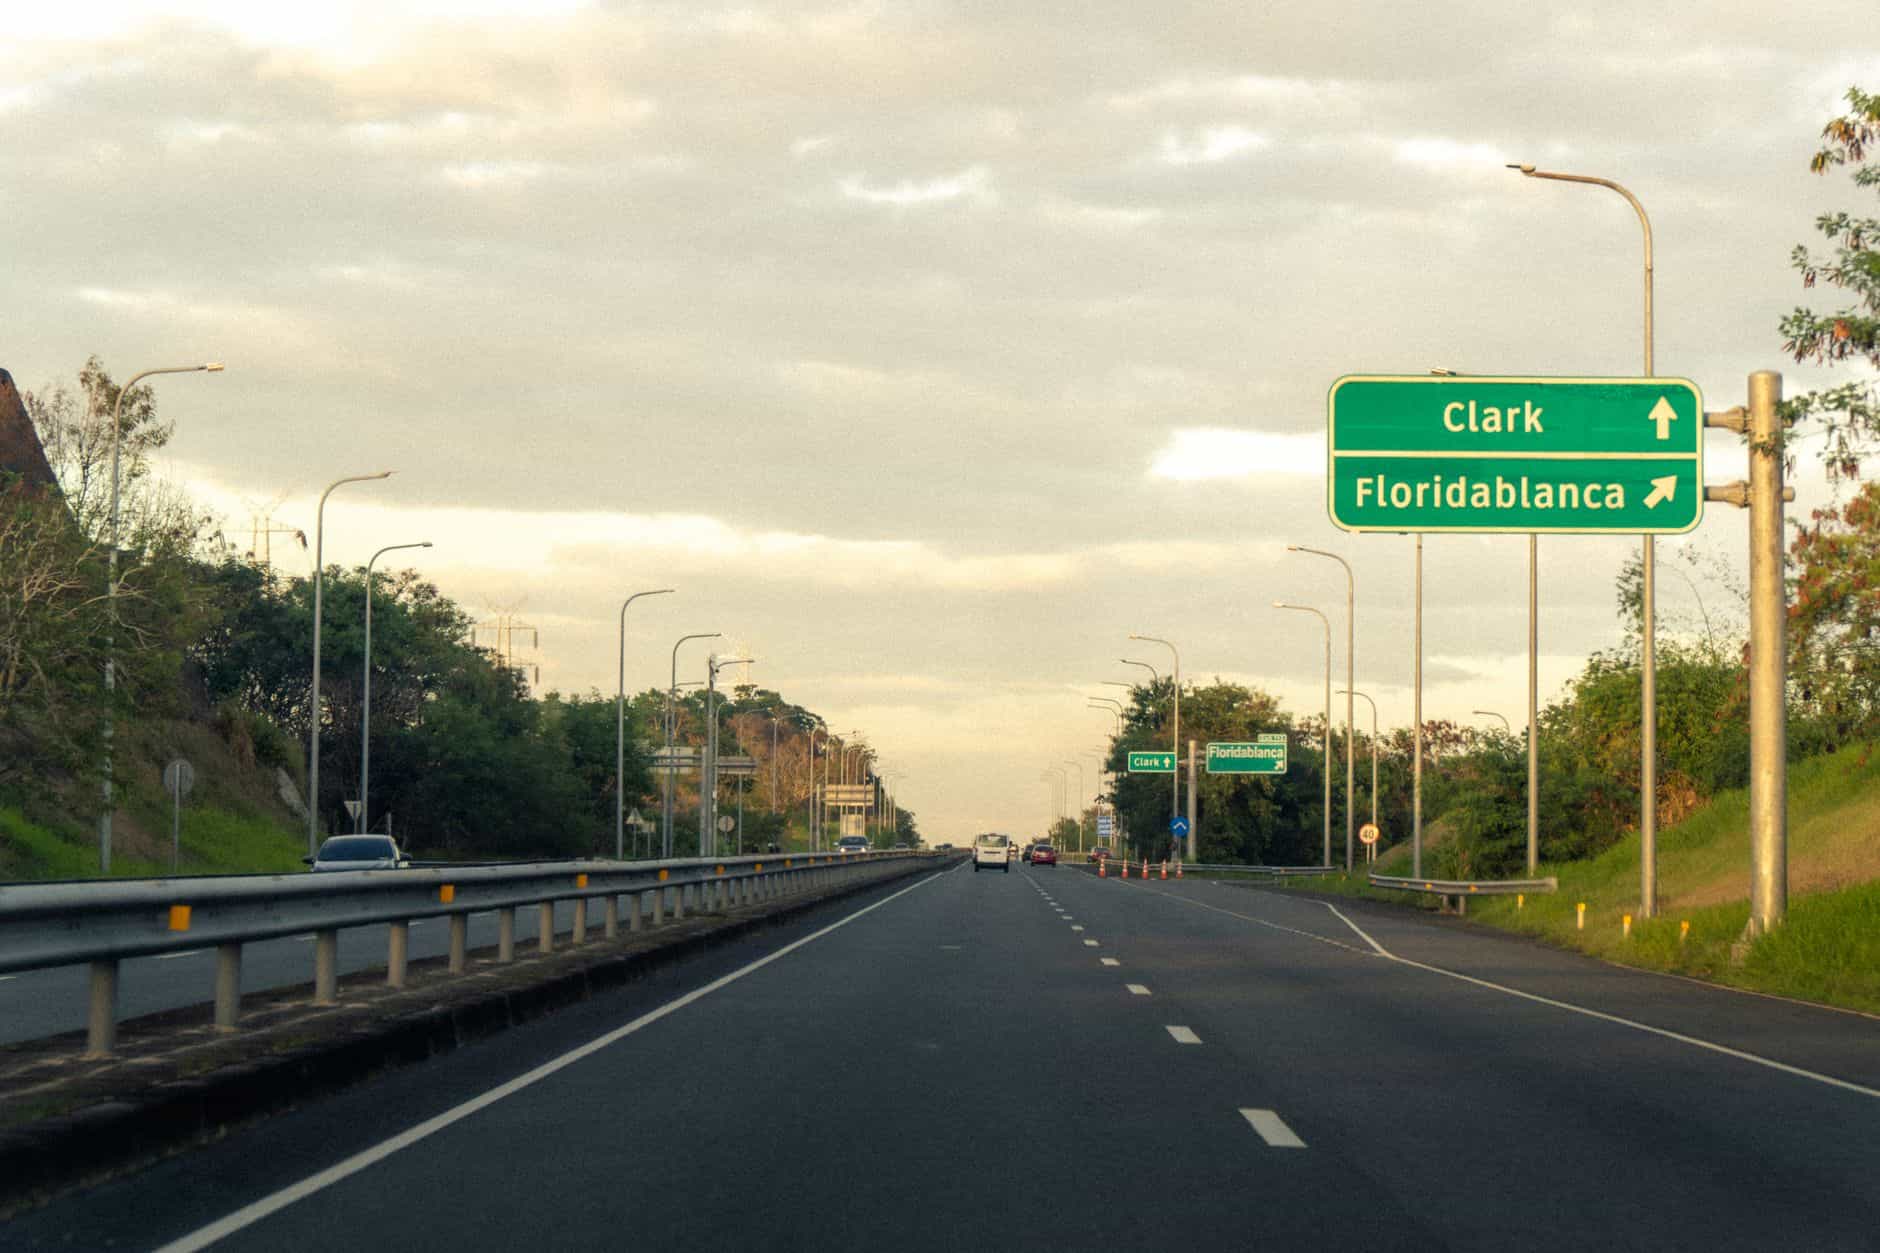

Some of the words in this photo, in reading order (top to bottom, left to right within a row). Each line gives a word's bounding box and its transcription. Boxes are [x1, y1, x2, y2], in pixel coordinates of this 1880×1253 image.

[1443, 400, 1543, 433] Clark
[1356, 473, 1625, 508] Floridablanca
[1209, 746, 1284, 758] Floridablanca
[1134, 757, 1160, 767] Clark
[1362, 828, 1375, 839] 40
